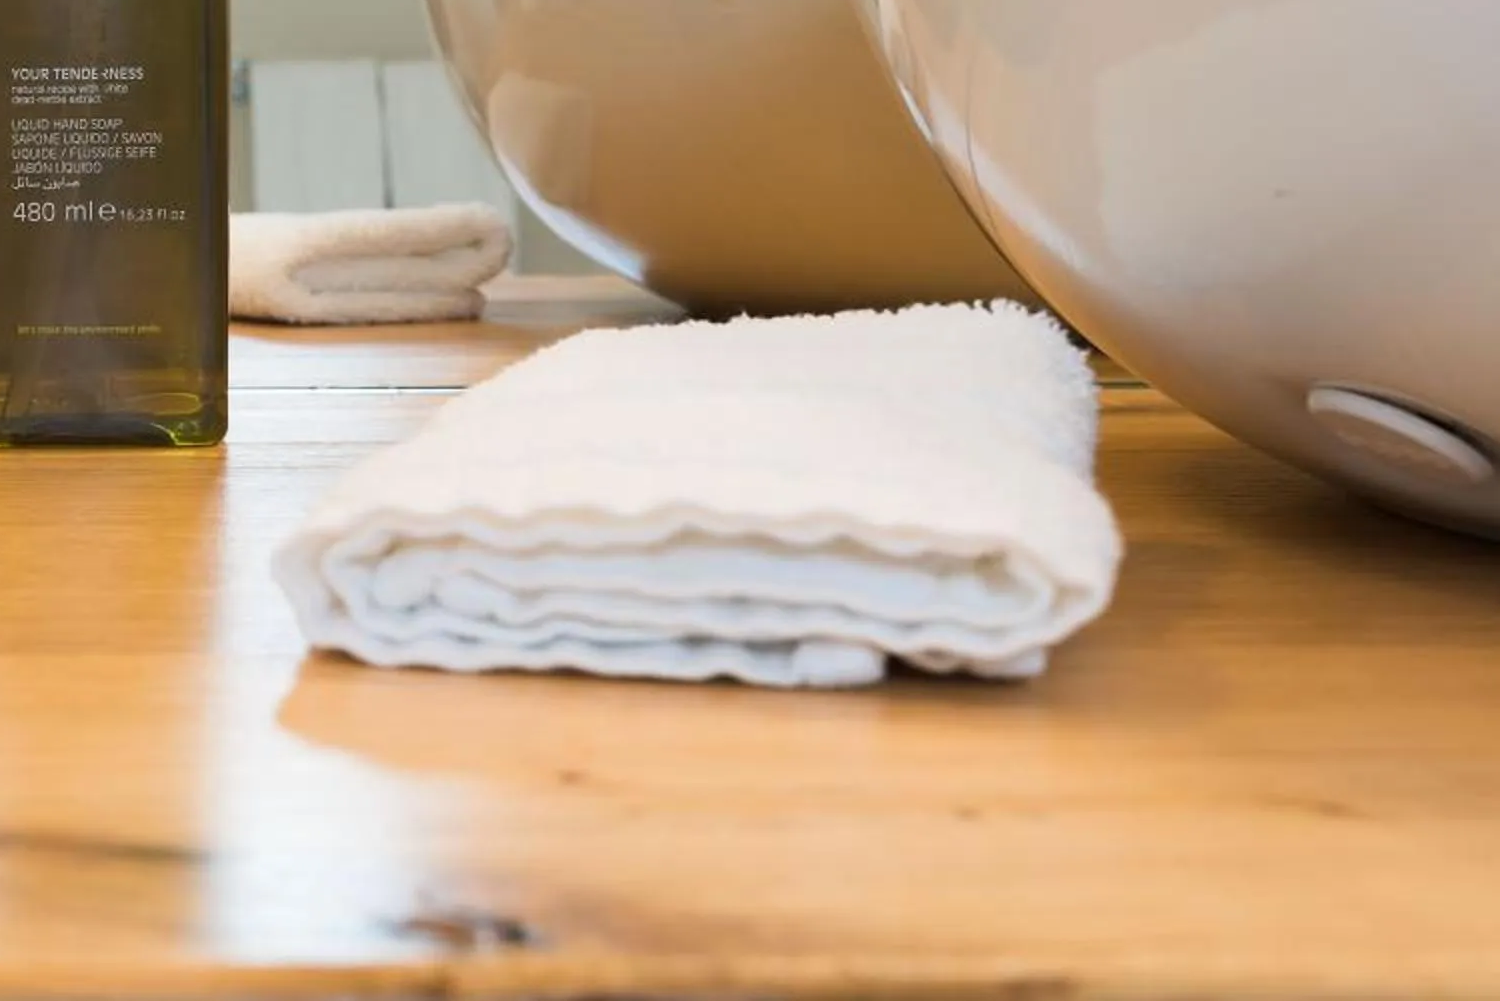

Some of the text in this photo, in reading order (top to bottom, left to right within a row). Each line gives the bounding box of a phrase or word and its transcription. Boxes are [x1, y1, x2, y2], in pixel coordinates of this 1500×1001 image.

[11, 67, 49, 80] YOUR
[11, 117, 124, 131] LIQUID HAND SOAP
[11, 132, 61, 146] SAPONE
[63, 132, 109, 145] LIQUIDO
[121, 131, 163, 145] SAVON
[11, 147, 57, 160] LIQUIDE
[125, 146, 158, 159] SEIFE
[12, 202, 56, 222] 480
